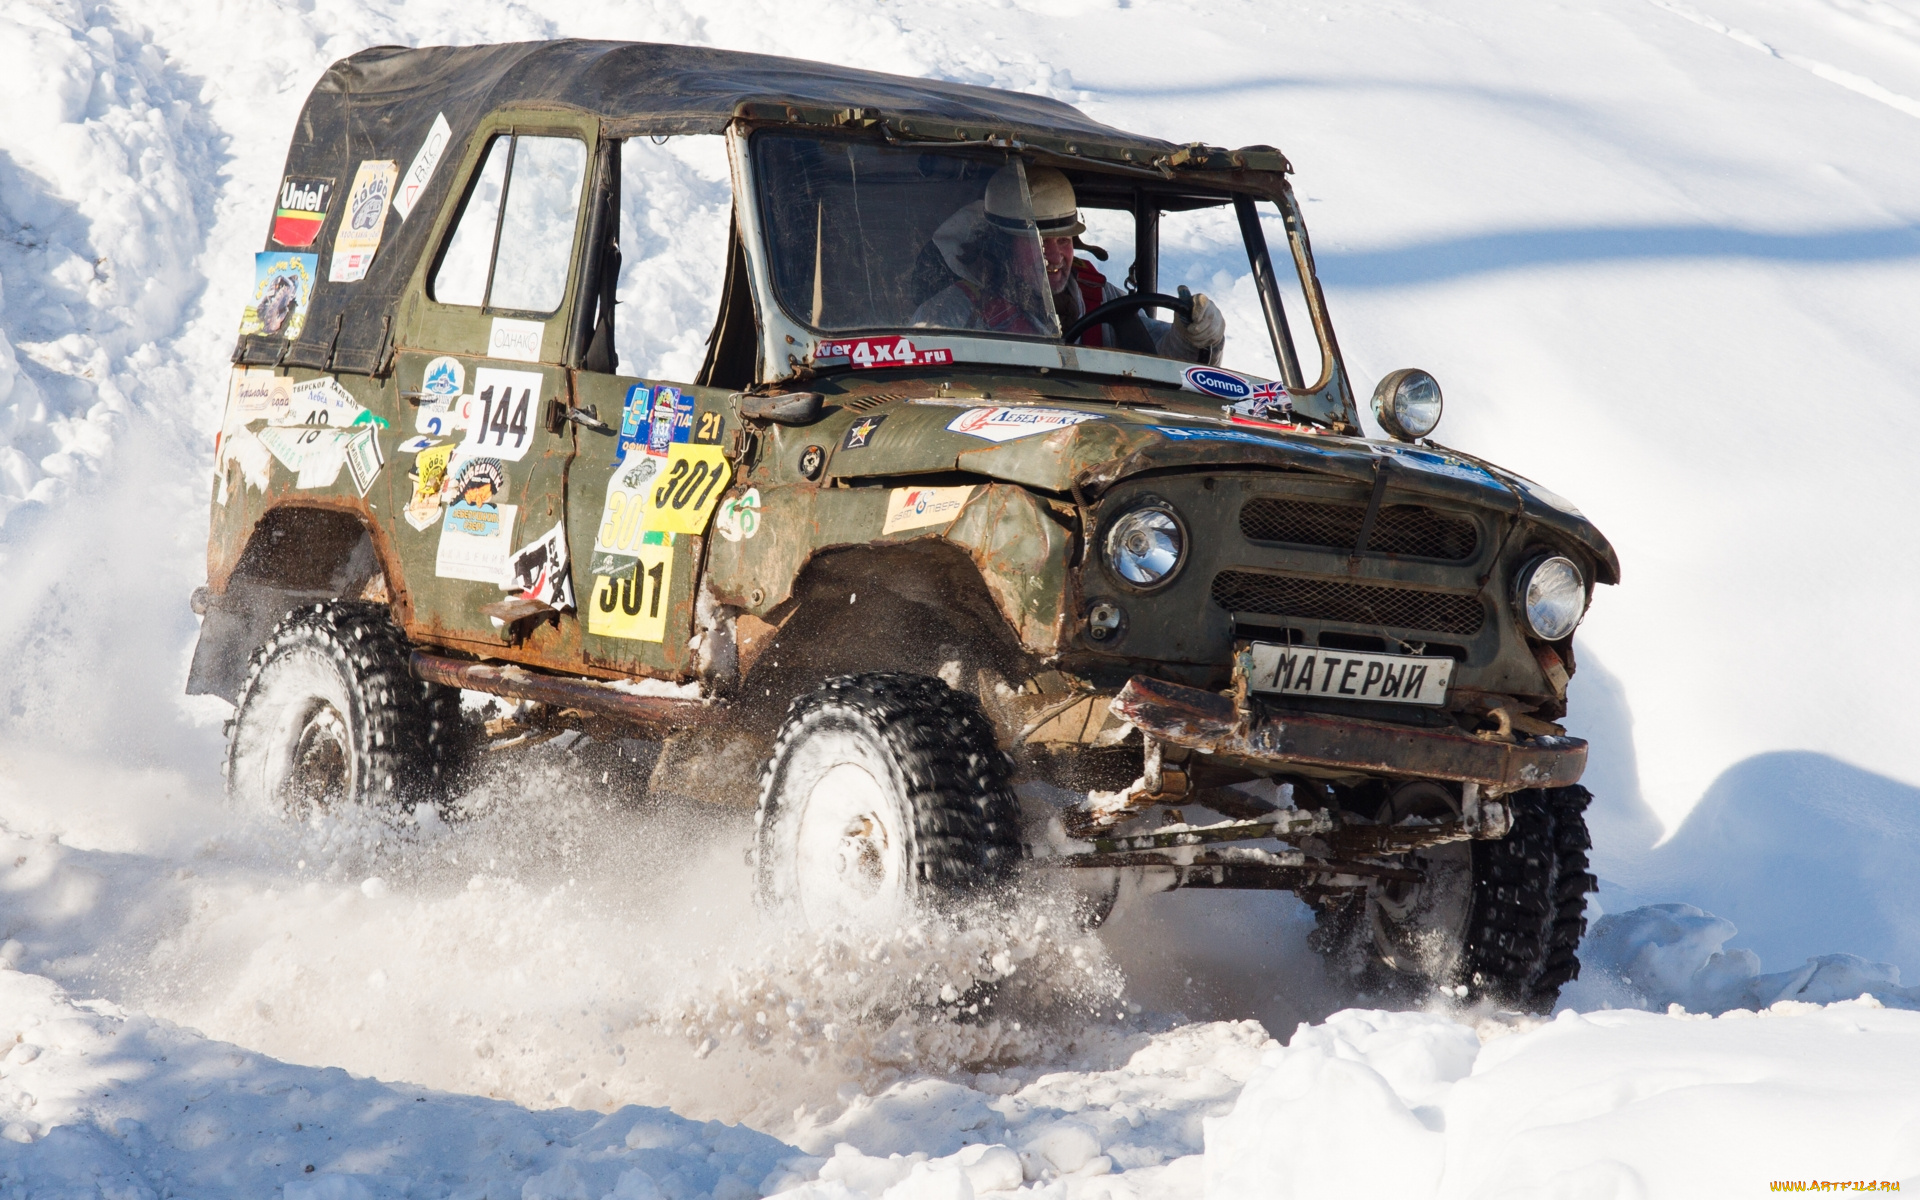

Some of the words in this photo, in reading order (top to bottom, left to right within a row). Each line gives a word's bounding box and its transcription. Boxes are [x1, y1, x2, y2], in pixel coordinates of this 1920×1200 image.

[281, 182, 325, 211] Uniel
[494, 329, 539, 351] ОДНАКО
[1196, 373, 1245, 394] Comma
[477, 385, 531, 448] 144
[698, 412, 721, 439] 21
[655, 458, 724, 511] 301
[1272, 653, 1428, 699] МАТЕРЫЙ
